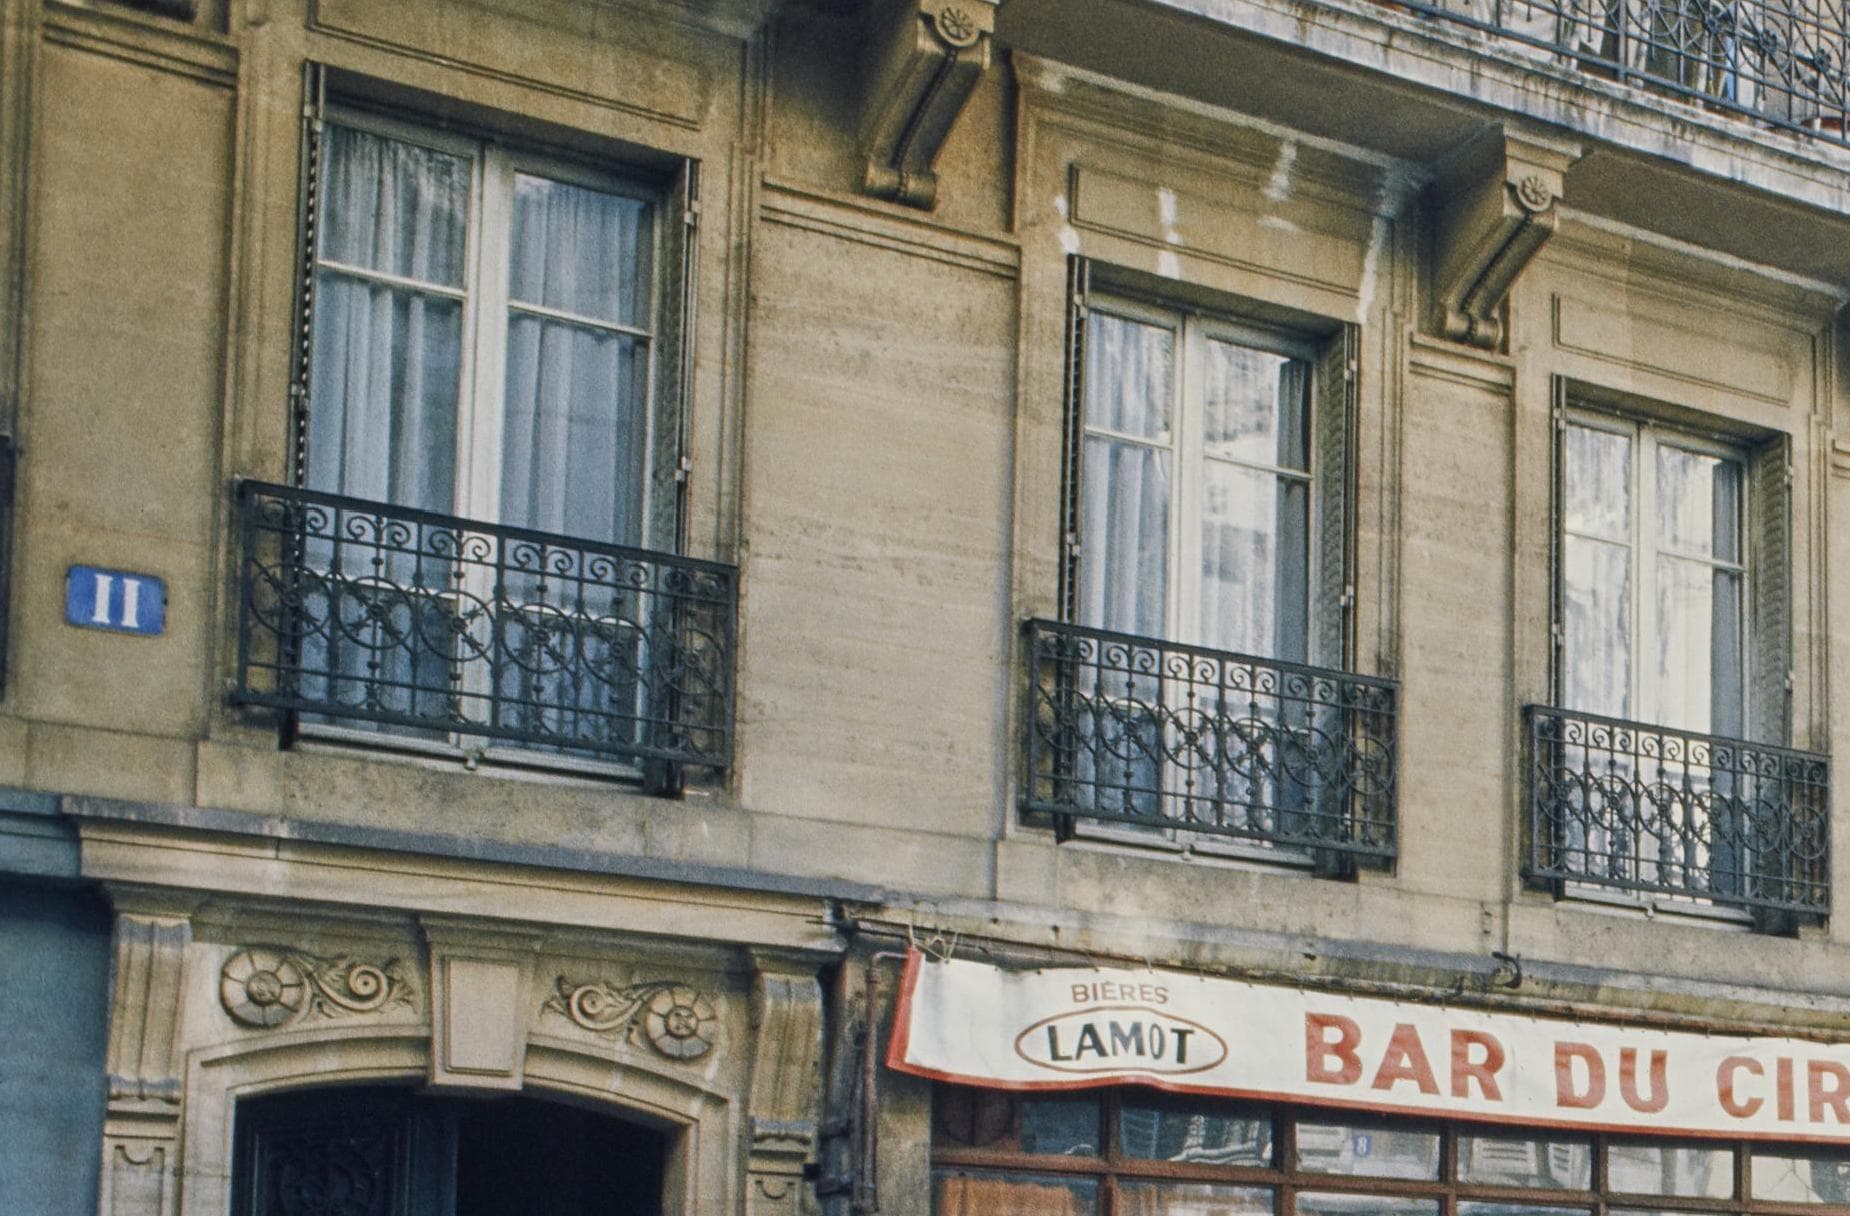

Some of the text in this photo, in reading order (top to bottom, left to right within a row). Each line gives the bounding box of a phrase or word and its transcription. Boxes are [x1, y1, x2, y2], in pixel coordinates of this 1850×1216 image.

[91, 573, 141, 628] 11
[1047, 1021, 1195, 1064] LAMOT
[1304, 1011, 1505, 1102] BAR
[1554, 1040, 1670, 1114] DU
